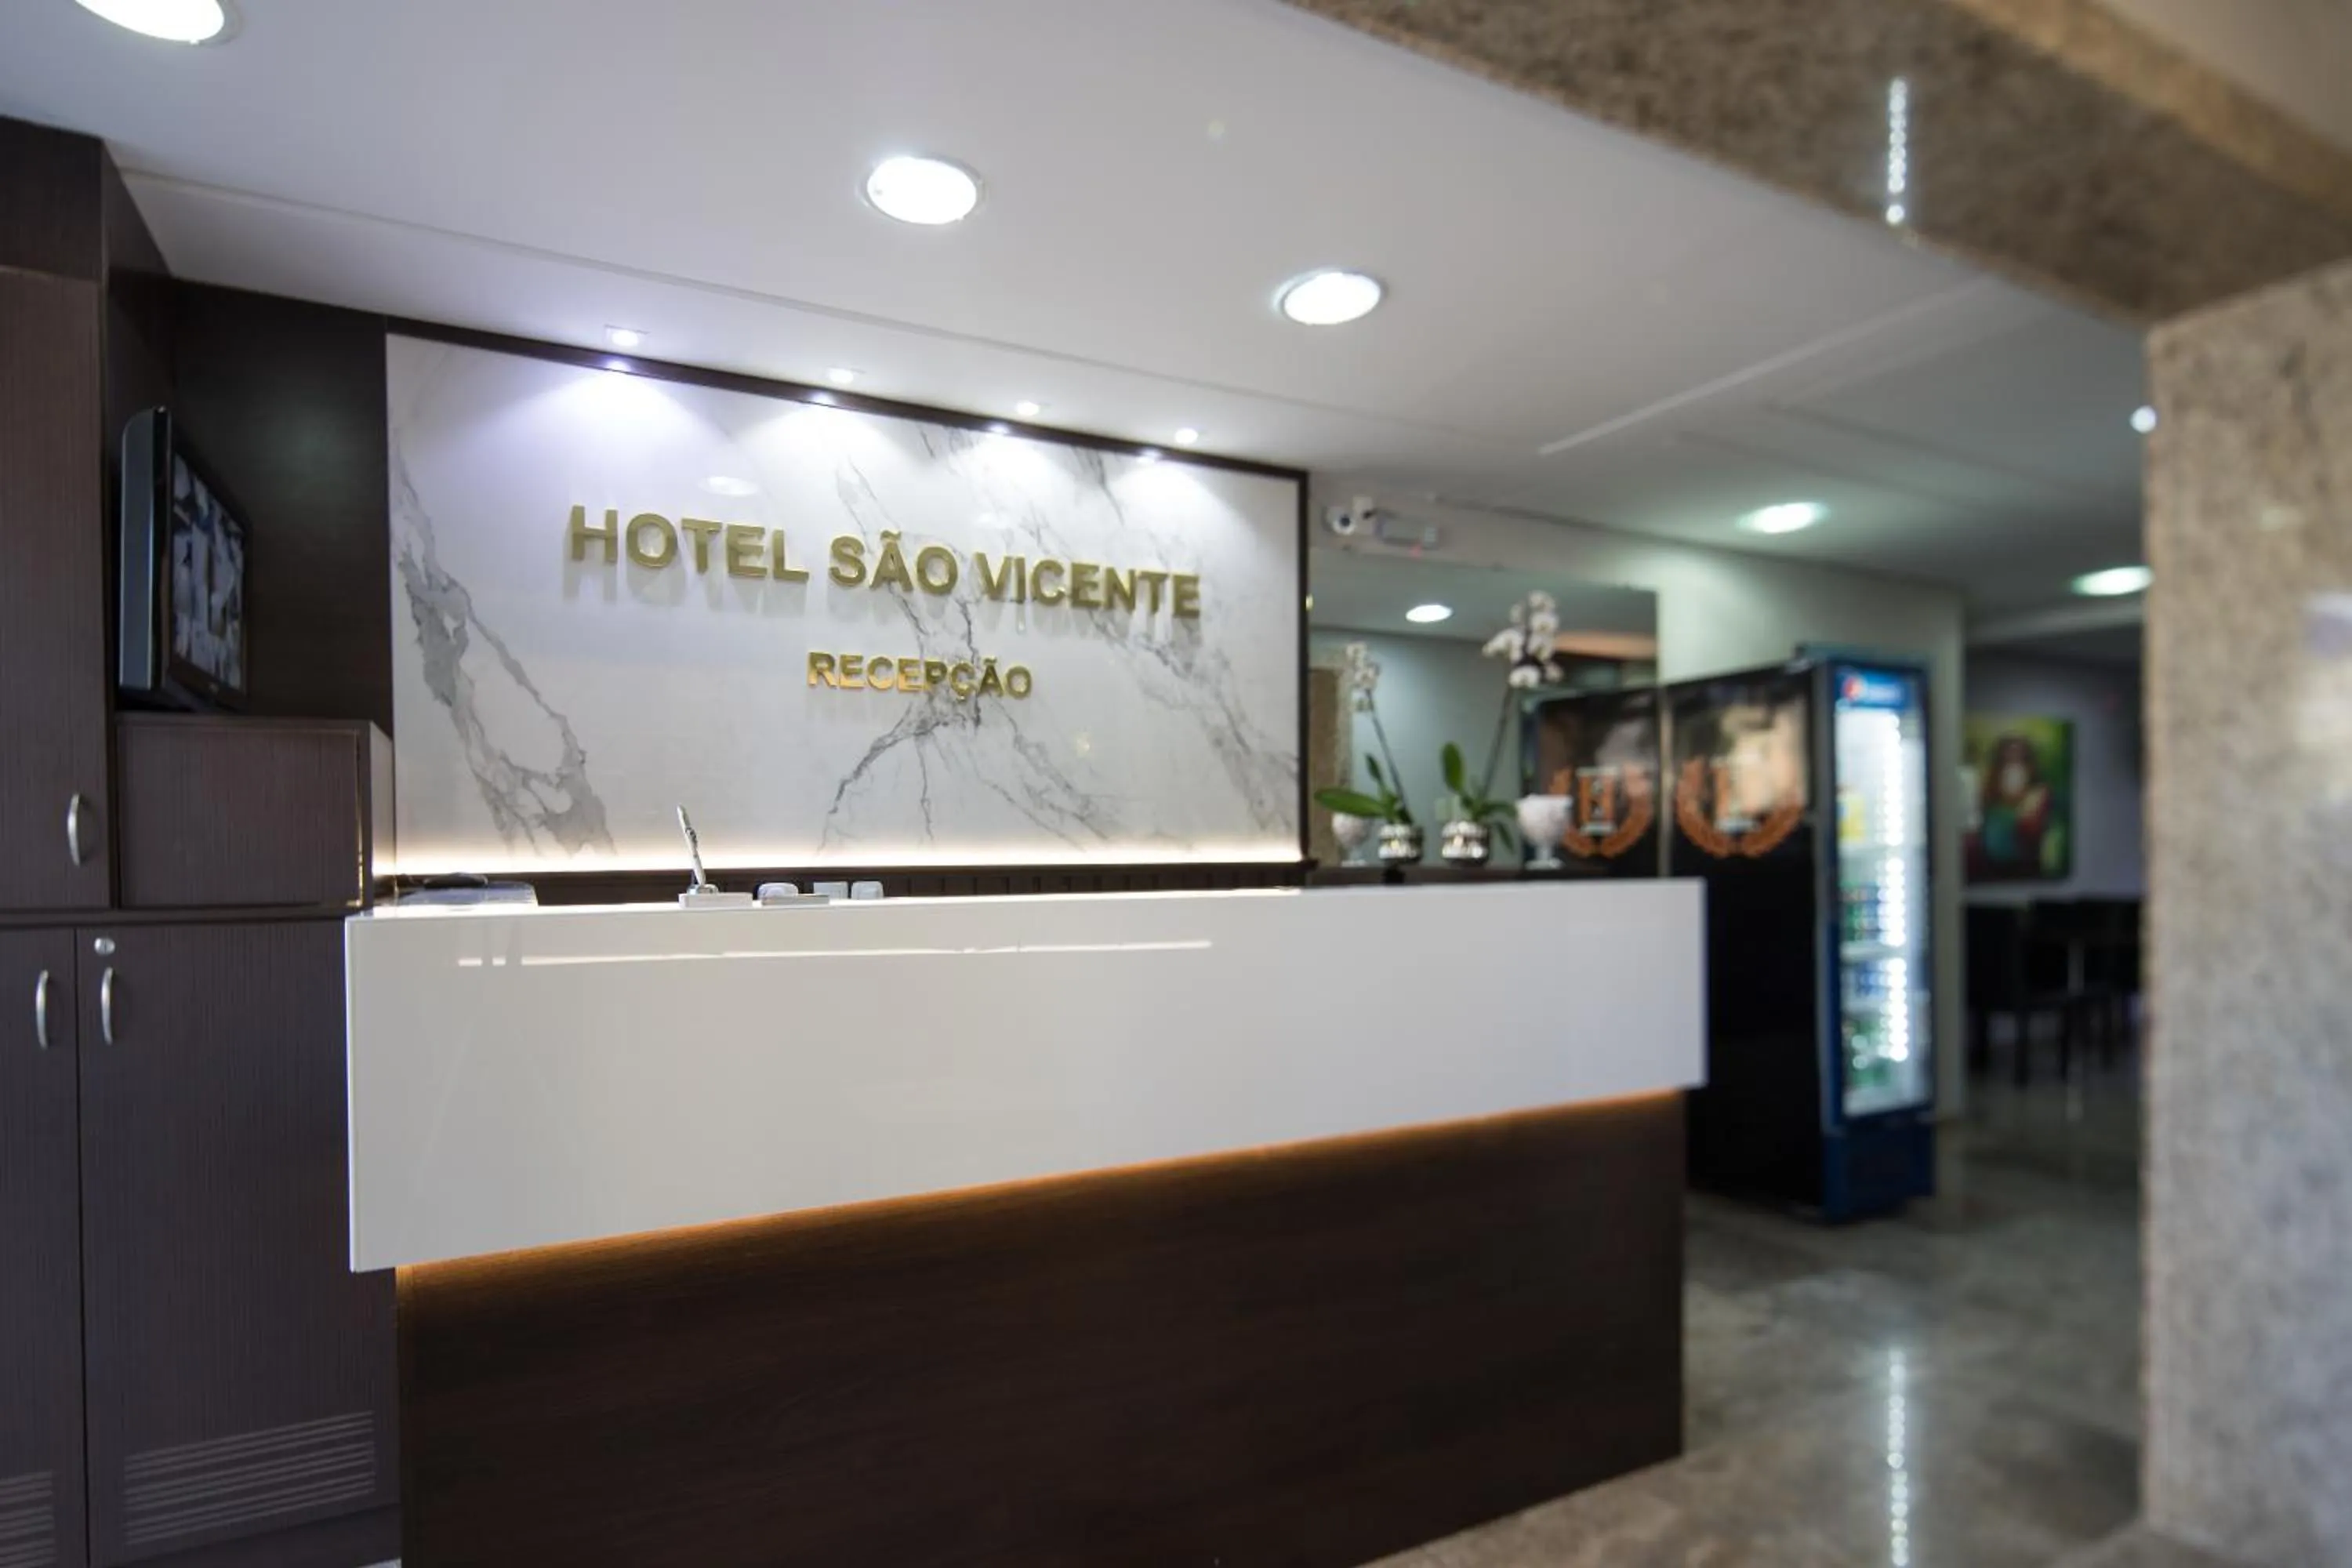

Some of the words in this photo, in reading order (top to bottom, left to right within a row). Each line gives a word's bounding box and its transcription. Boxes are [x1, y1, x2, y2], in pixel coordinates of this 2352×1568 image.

[571, 506, 809, 583] HOTEL
[829, 530, 958, 595] SÃO
[974, 552, 1201, 618] VICENTE
[808, 652, 1033, 702] RECEPÇÃO
